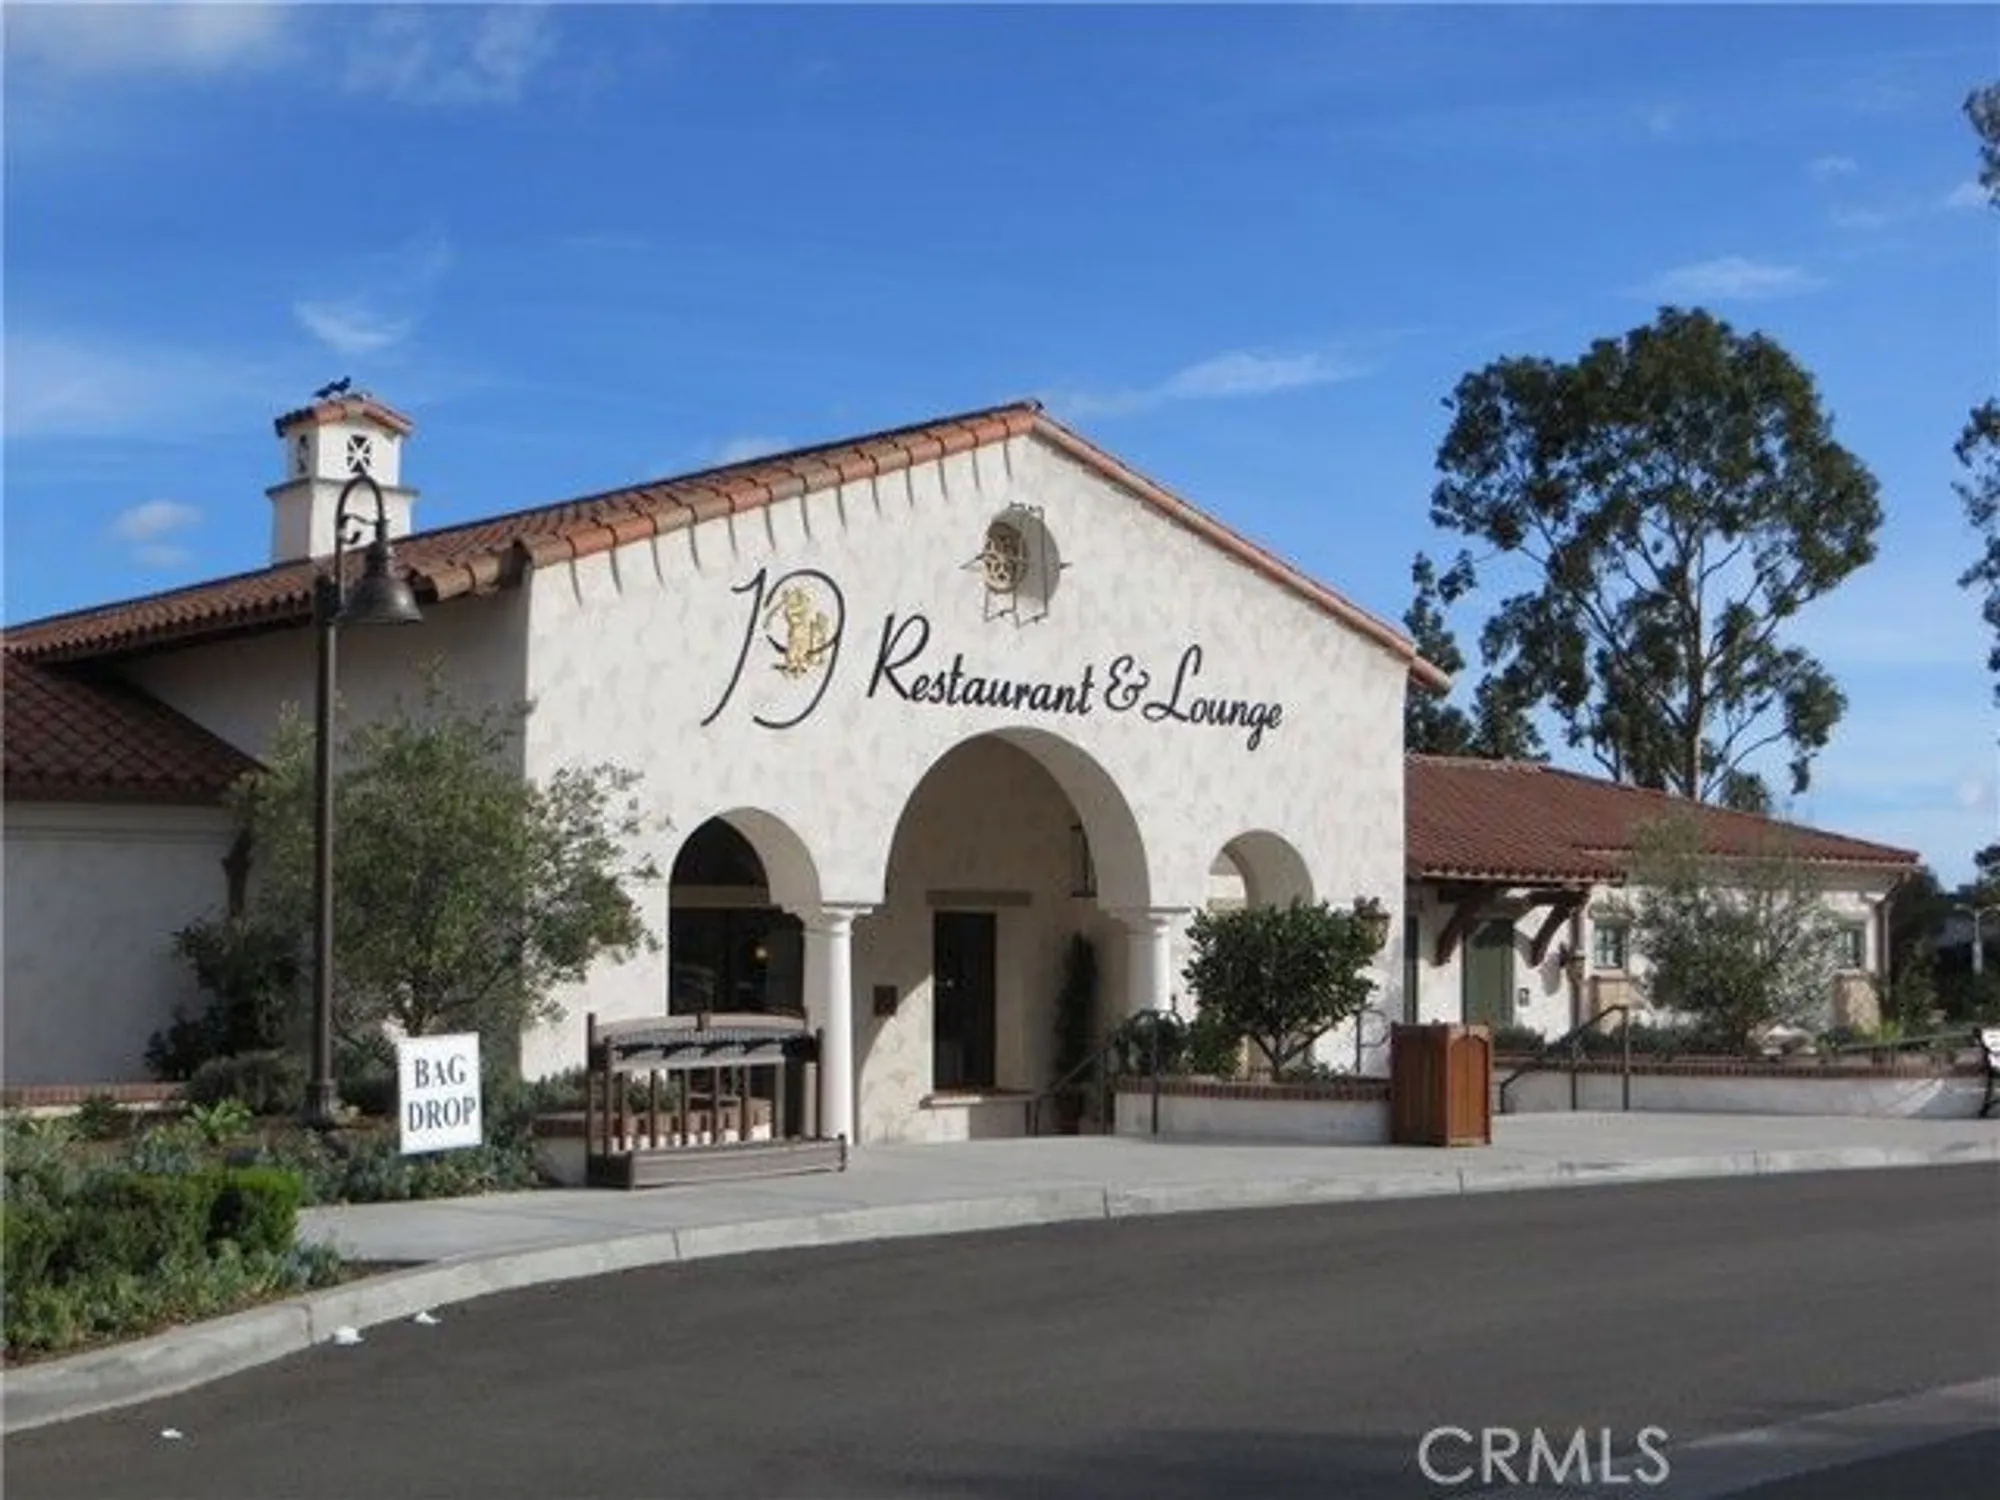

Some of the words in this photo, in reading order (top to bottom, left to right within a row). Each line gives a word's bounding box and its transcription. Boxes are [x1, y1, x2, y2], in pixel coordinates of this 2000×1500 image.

[701, 568, 845, 729] 19
[866, 613, 1095, 716] Restaurant
[1104, 654, 1150, 706] &
[1143, 643, 1283, 750] Lounge
[414, 1053, 468, 1089] BAG
[408, 1095, 477, 1132] DROP
